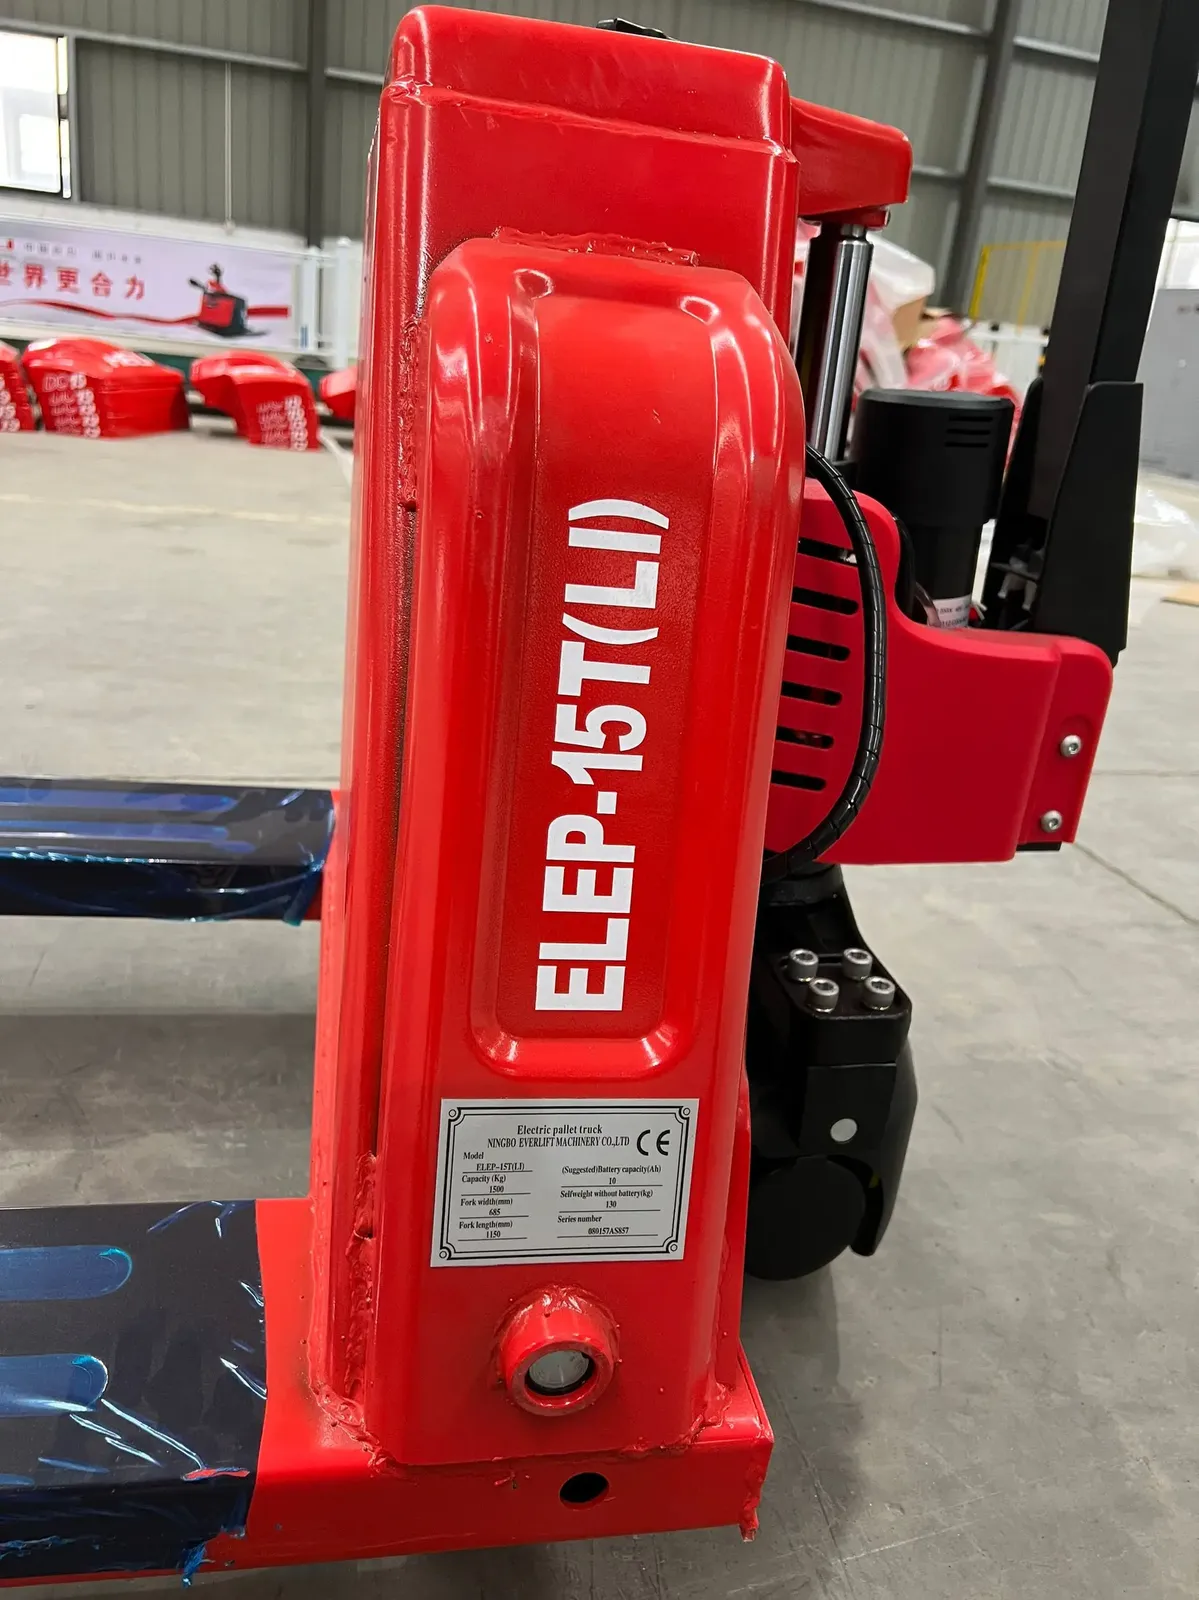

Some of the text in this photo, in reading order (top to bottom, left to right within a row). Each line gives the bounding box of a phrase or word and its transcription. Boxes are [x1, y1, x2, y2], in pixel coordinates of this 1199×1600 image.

[535, 498, 670, 1012] ELEP-15T(LI)
[517, 1125, 602, 1136] Electric pallet truck
[488, 1137, 630, 1148] NINGBO EVERLIFT MACHINERY CO.,LTD
[476, 1163, 525, 1171] ELEP-15T(LI)
[622, 1165, 661, 1174] capacity(Ah)
[462, 1174, 506, 1184] Capacity (Kg)
[459, 1221, 513, 1229] Fork length(mm)
[486, 1230, 501, 1238] 1150
